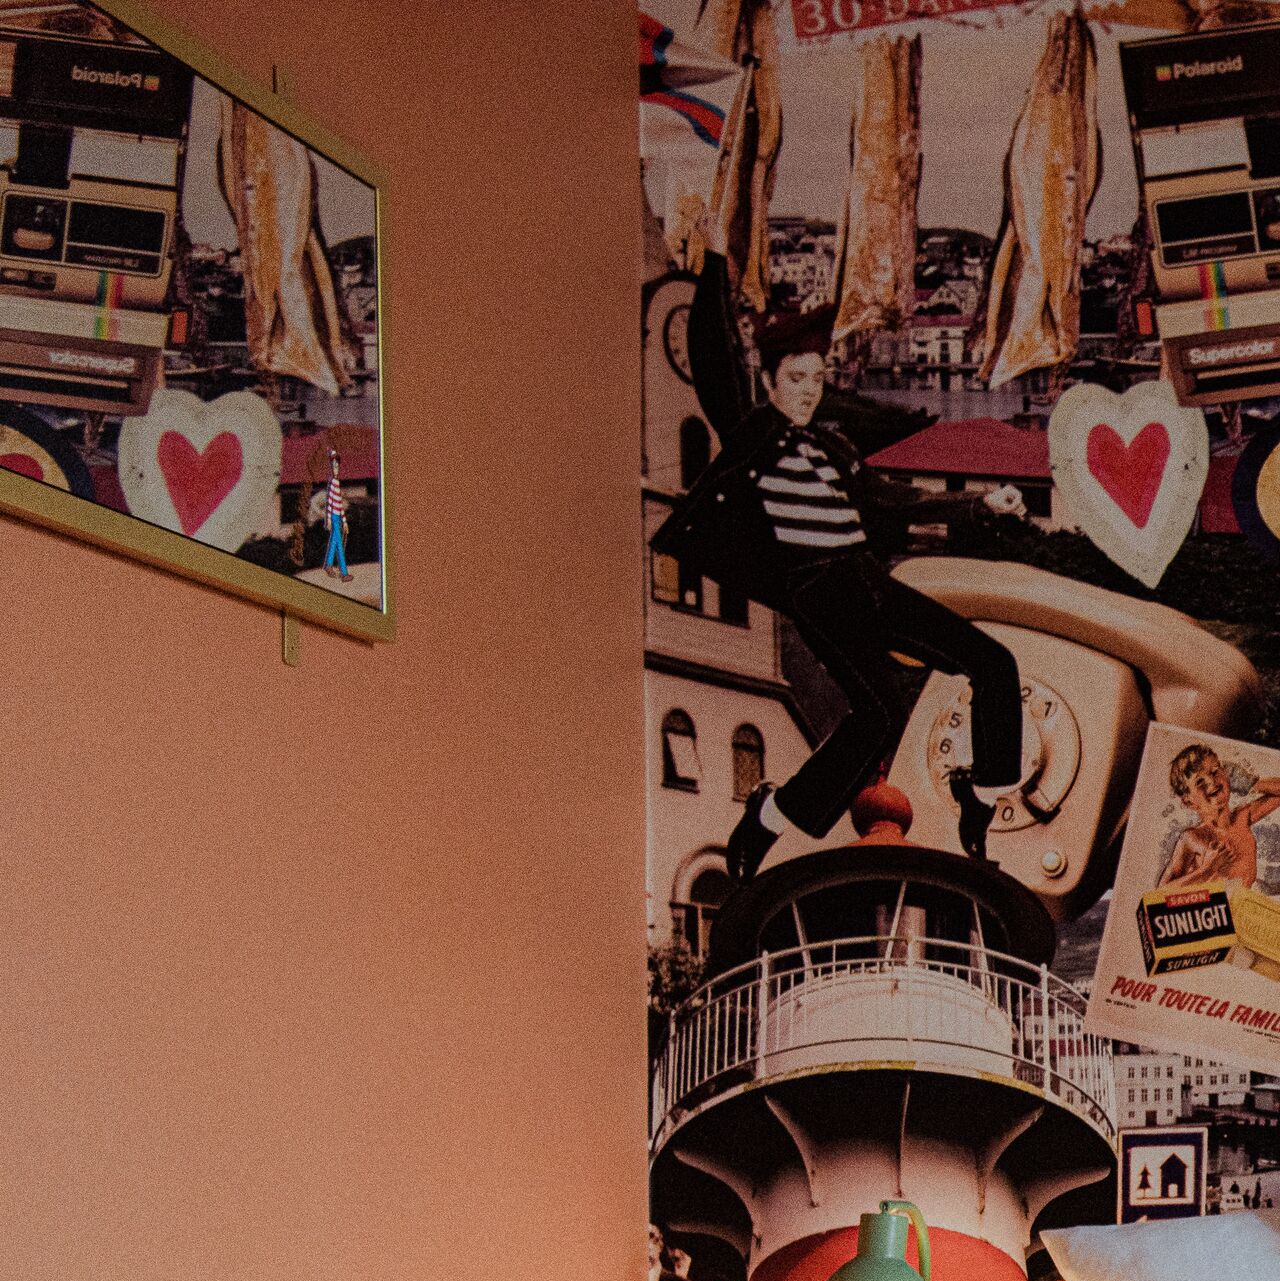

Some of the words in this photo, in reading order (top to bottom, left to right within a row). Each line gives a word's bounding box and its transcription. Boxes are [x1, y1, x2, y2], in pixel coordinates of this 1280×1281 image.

[1173, 54, 1244, 79] Polaroid
[1189, 341, 1275, 365] Supercolor
[949, 712, 961, 729] 5
[940, 738, 952, 754] 6
[1001, 805, 1014, 822] 0
[1170, 892, 1208, 906] SAVON
[1154, 904, 1229, 940] SUNLIGHT
[1110, 974, 1157, 1003] POUR
[1159, 987, 1211, 1014] TOUTE
[1206, 1000, 1230, 1018] LA
